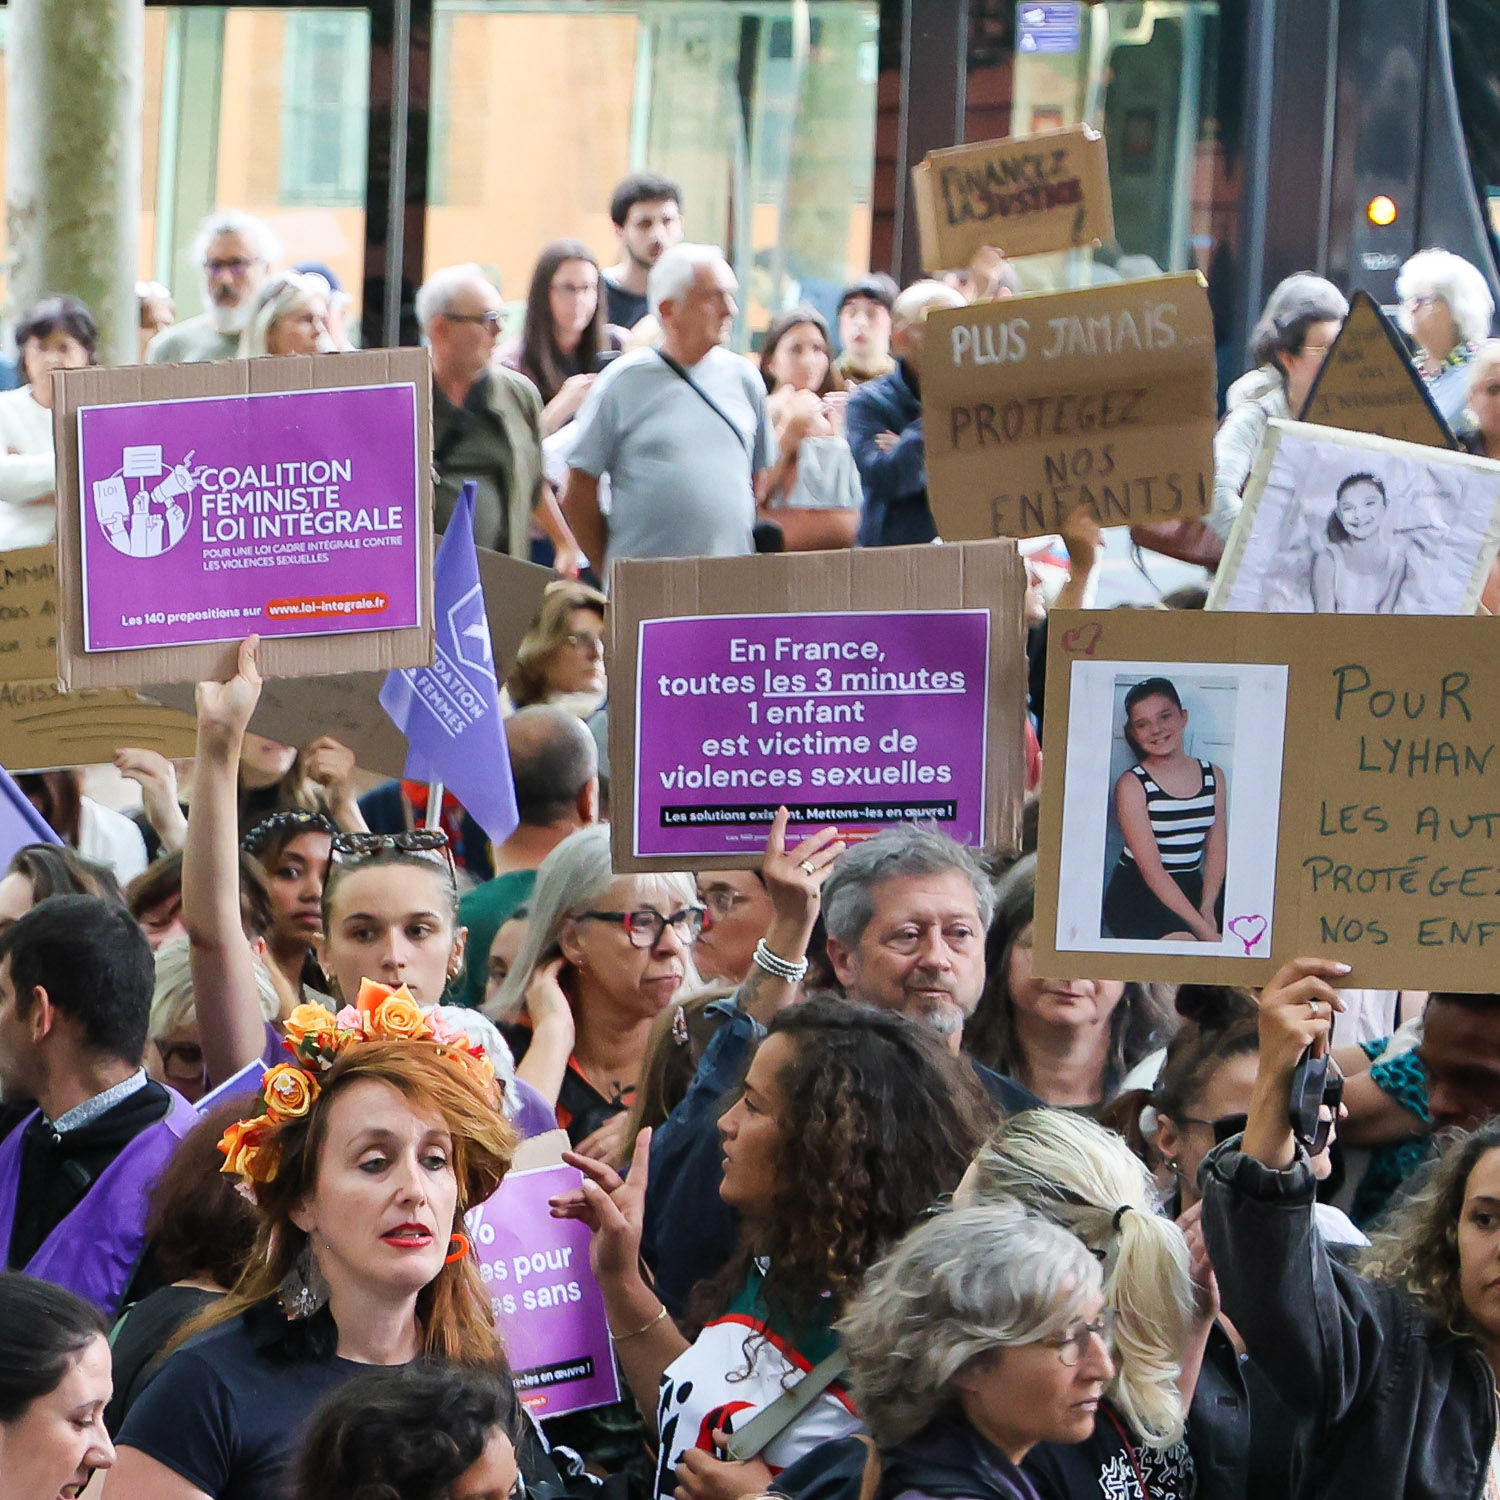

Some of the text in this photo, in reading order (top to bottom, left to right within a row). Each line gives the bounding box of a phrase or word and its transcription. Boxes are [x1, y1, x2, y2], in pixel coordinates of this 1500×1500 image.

[951, 318, 1031, 368] PLUS
[200, 459, 352, 492] COALITION
[1043, 443, 1117, 486] NOS
[201, 485, 340, 518] FÉMINISTE
[202, 506, 403, 543] LOI INTÉGRALE
[203, 547, 230, 559] POUR
[232, 546, 253, 557] UNE
[255, 545, 271, 556] LOI
[273, 543, 305, 555] CADRE
[362, 536, 403, 548] CONTRE
[203, 553, 330, 572] LES VIOLENCES SEXUELLES
[121, 606, 262, 627] Les 140 propositions sur
[268, 596, 385, 616] www.loi-integrale.fr
[730, 637, 887, 664] En France,
[433, 655, 486, 719] DATION
[658, 666, 966, 697] toutes les 3 minutes
[1332, 664, 1472, 722] POUR
[415, 674, 468, 735] FEMMES
[747, 699, 866, 725] 1 enfant
[701, 728, 919, 758] est victime de
[1358, 736, 1495, 778] LYHAN
[659, 760, 952, 790] violences sexuelles
[665, 811, 688, 823] Les
[689, 809, 747, 823] solutions
[806, 807, 884, 821] Mettons-les
[886, 808, 902, 819] en
[1320, 801, 1390, 837] LES
[1319, 915, 1390, 946] NOS
[514, 1246, 573, 1284] pour
[522, 1280, 583, 1311] sans
